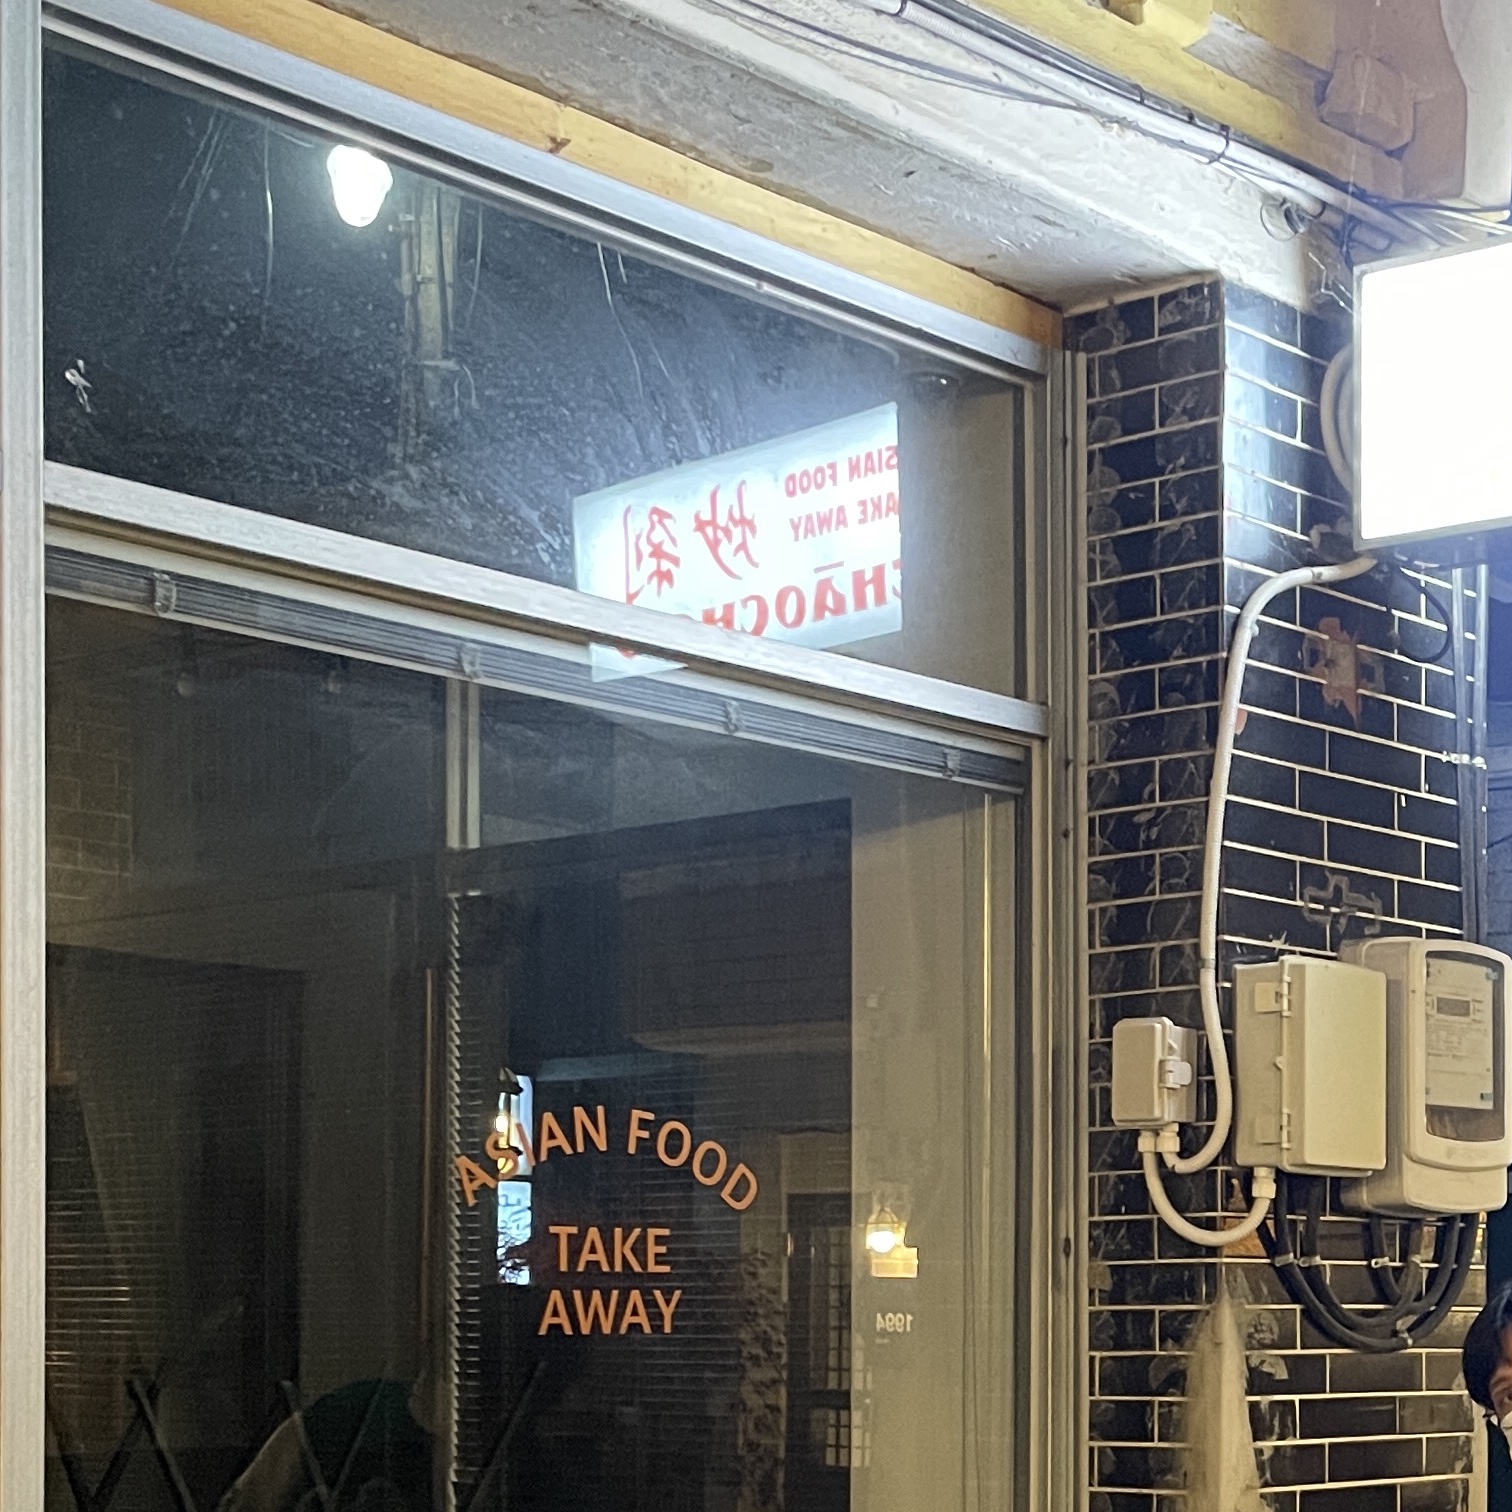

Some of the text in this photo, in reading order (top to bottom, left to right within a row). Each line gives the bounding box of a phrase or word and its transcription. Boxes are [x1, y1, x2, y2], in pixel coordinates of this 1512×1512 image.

[455, 1105, 758, 1210] ASIAN FOOD
[549, 1225, 672, 1274] TAKE
[538, 1290, 682, 1336] AWAY
